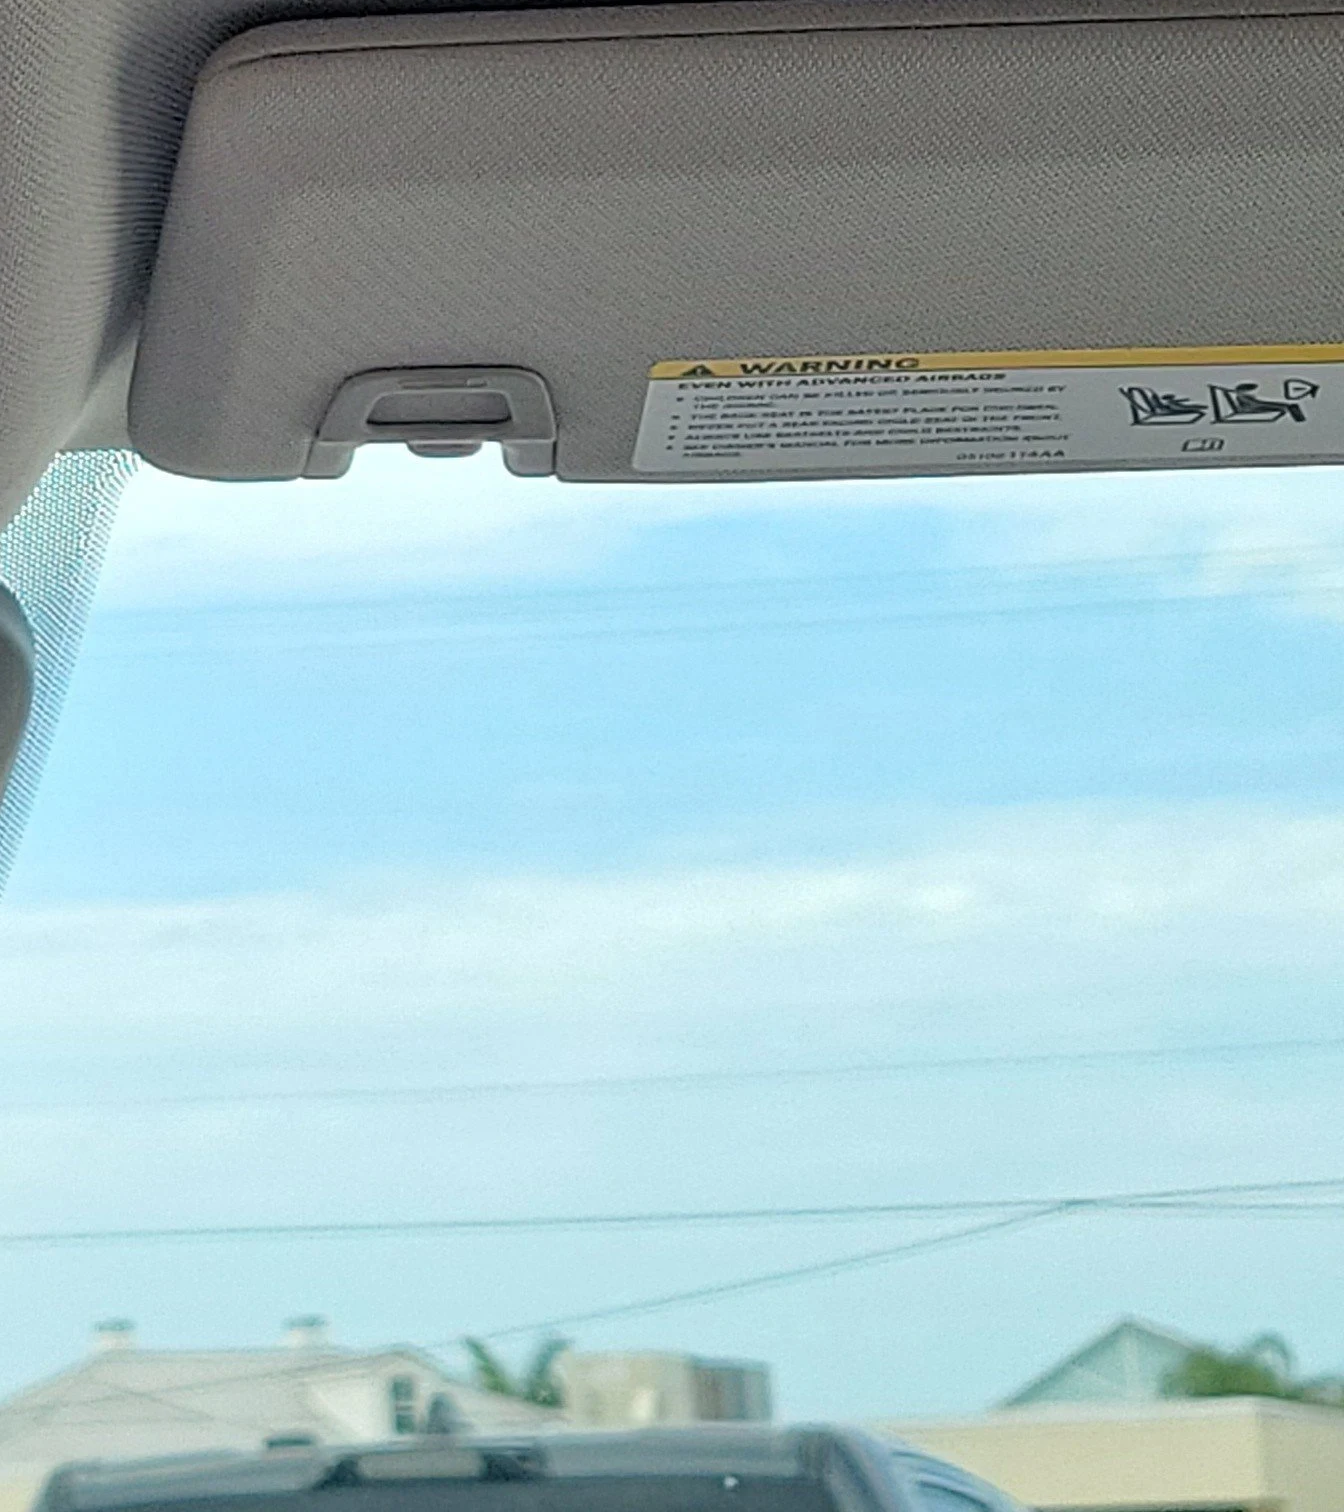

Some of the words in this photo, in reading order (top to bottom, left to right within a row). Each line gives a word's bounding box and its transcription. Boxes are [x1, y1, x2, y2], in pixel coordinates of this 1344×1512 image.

[740, 357, 919, 375] WARNING
[678, 381, 731, 389] EVEN
[738, 380, 791, 388] WITH
[796, 376, 911, 386] ADVANCED
